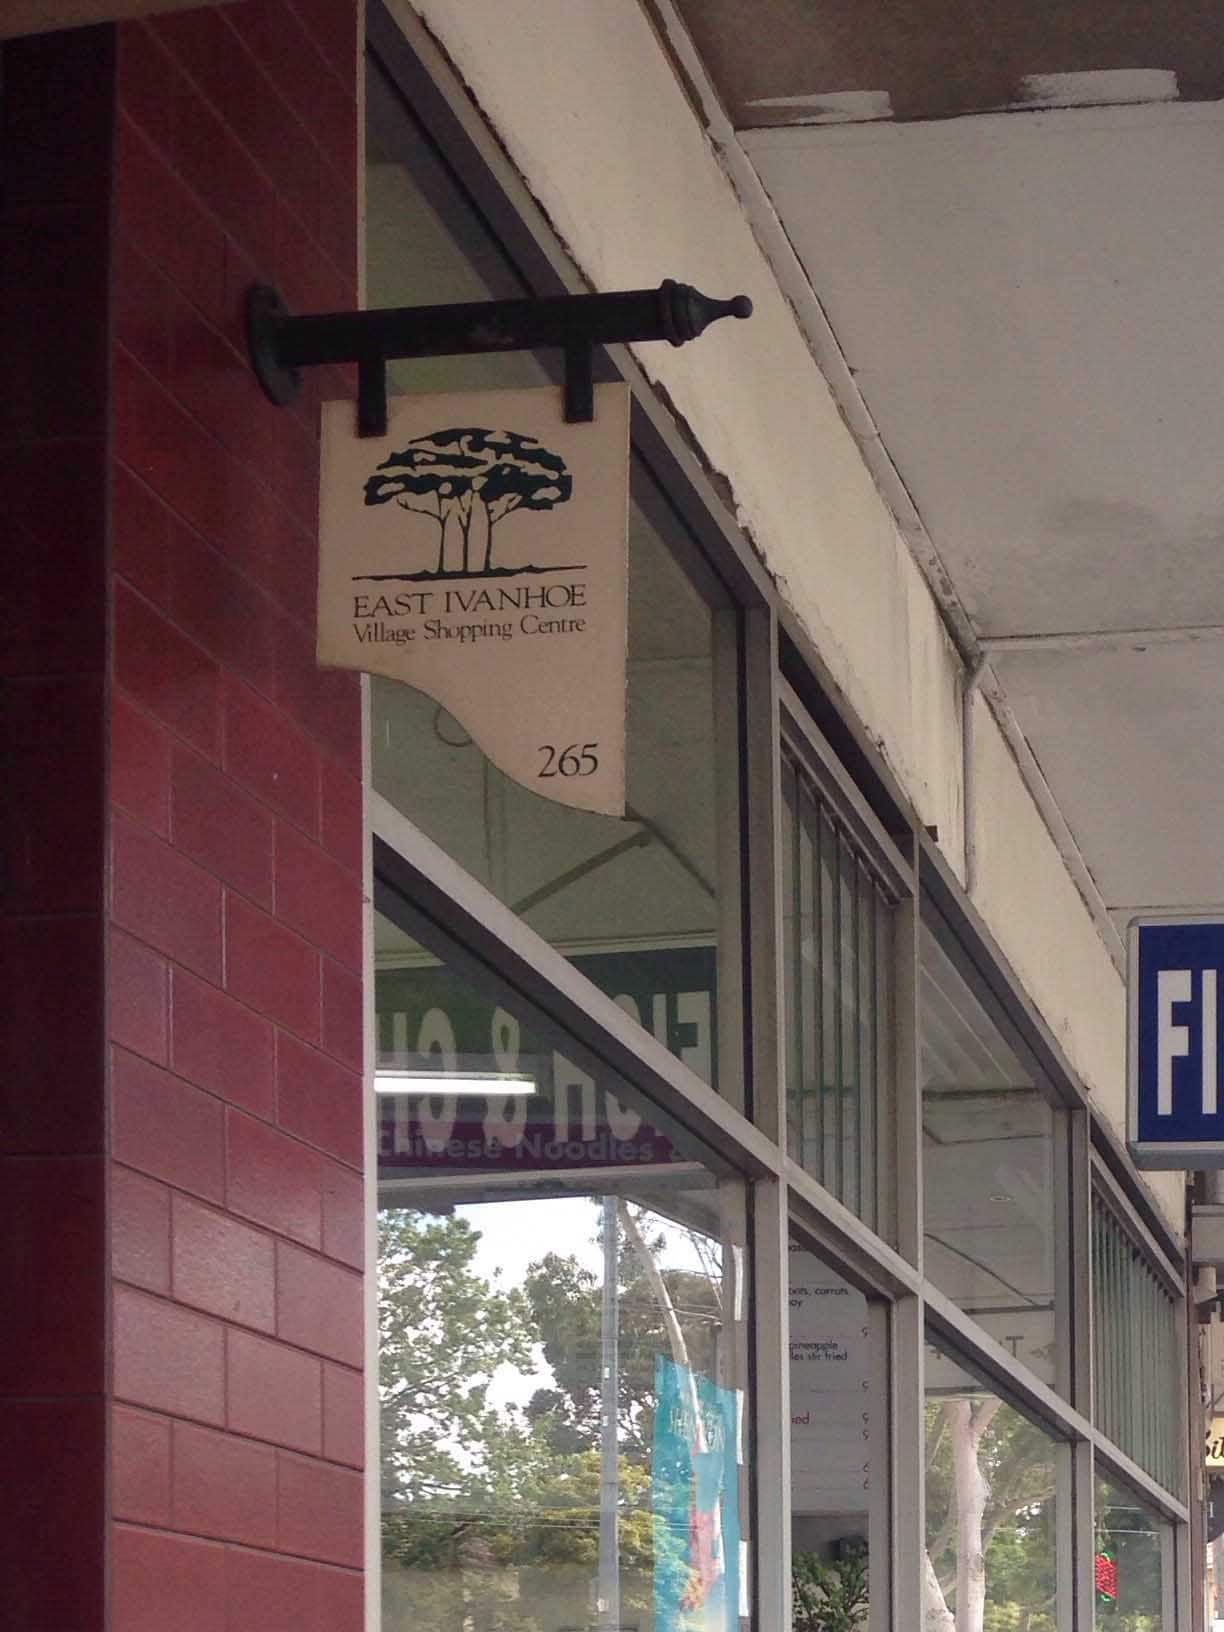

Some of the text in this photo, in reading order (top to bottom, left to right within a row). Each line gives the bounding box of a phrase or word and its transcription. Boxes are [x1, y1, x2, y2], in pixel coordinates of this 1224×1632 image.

[353, 584, 587, 618] EAST IVANHOE
[353, 614, 587, 646] Village Shopping Centre
[537, 743, 600, 779] 265
